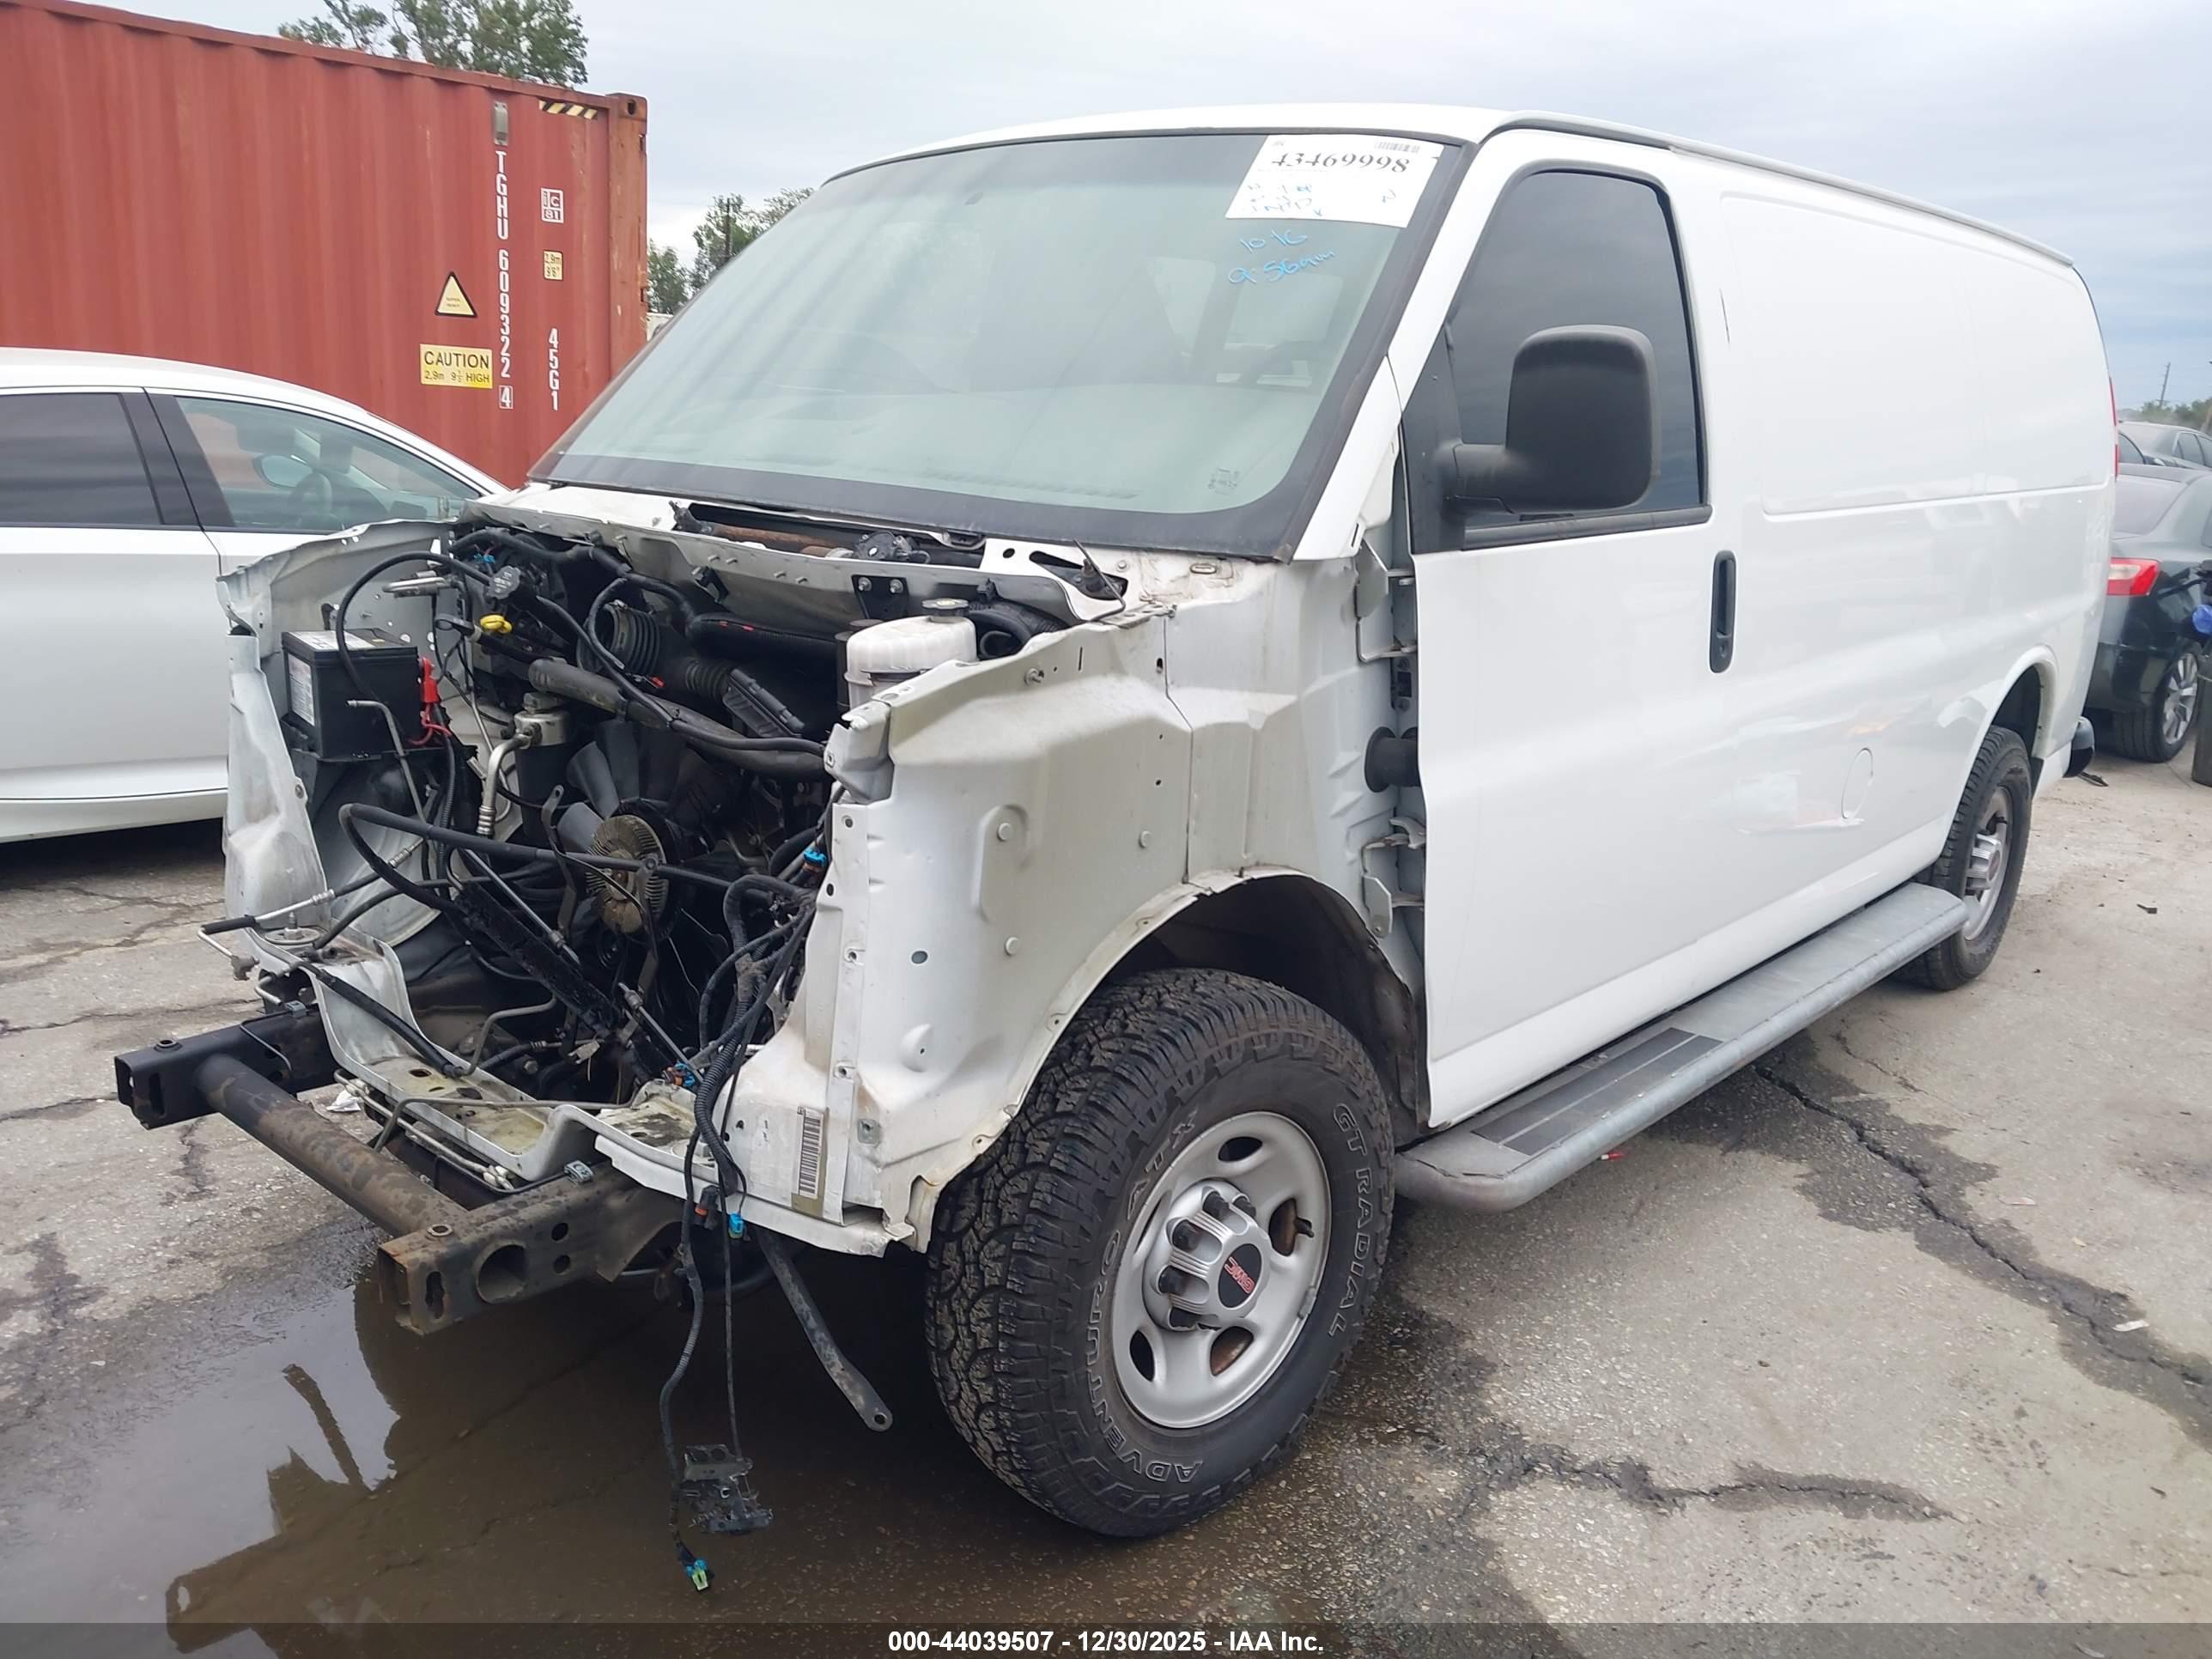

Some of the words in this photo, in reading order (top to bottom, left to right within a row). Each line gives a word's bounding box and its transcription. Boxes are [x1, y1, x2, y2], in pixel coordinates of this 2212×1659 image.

[495, 150, 509, 240] TGHU
[1272, 152, 1410, 173] 43469998
[499, 248, 510, 379] 609322
[424, 350, 489, 368] CAUTION
[465, 372, 490, 383] HIGH
[549, 327, 559, 411] 45G1
[1334, 1103, 1368, 1157] GT
[1224, 1256, 1255, 1294] GMC
[1328, 1167, 1373, 1337] RADIAL
[1086, 1229, 1204, 1483] ADVENTURO
